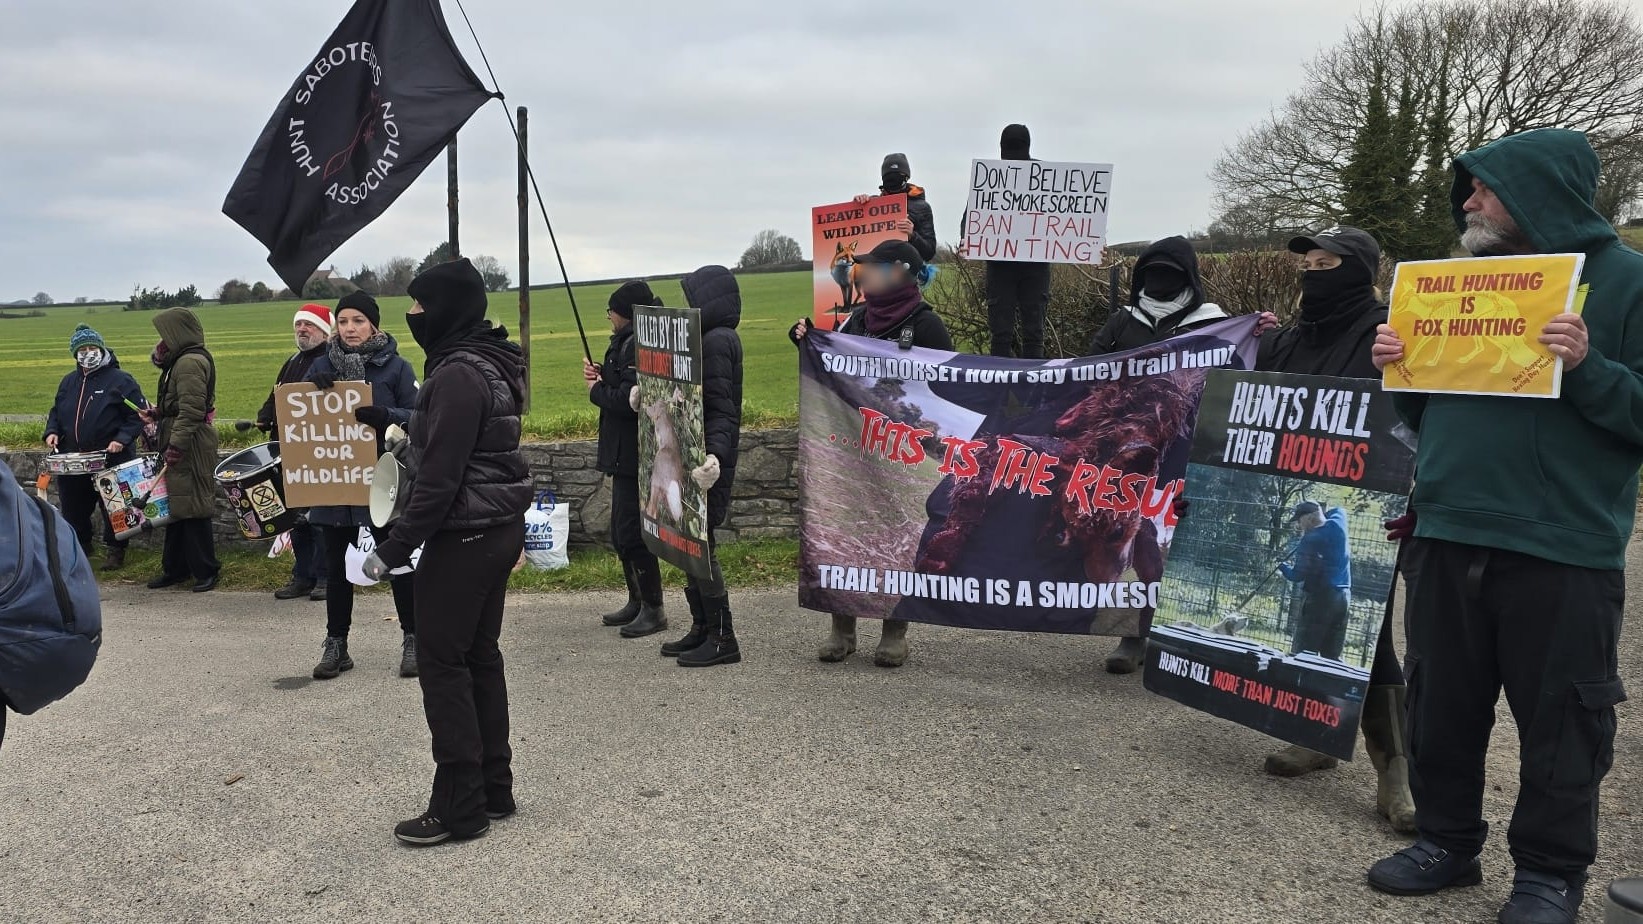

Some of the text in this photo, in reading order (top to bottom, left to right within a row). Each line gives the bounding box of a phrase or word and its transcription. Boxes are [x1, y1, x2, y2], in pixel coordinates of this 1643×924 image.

[289, 117, 321, 177] HUNT
[324, 101, 401, 205] ASSOCIATION
[1028, 162, 1110, 194] BELIEVE
[817, 203, 901, 225] LEAVE OUR
[973, 188, 1108, 214] THE SMOKESCREEN
[823, 220, 896, 240] WILDLIFE
[968, 210, 1012, 235] BAN
[1416, 272, 1544, 293] TRAIL HUNTING
[1460, 297, 1475, 314] IS
[637, 314, 690, 352] KILLED BY THE
[1413, 318, 1527, 337] FOX HUNTING
[673, 353, 692, 381] HUNT
[821, 344, 1237, 385] SOUTH DORSET HUNT say they trail hunt
[1512, 355, 1544, 384] Don't Support
[1528, 370, 1540, 380] Day
[286, 389, 361, 418] STOP
[1228, 382, 1371, 438] HUNTS KILL
[314, 444, 354, 460] OUR
[1223, 428, 1369, 481] THEIR HOUNDS
[937, 436, 988, 485] IS
[988, 438, 1060, 499] THE
[818, 564, 879, 593] TRAIL
[884, 569, 980, 604] HUNTING
[986, 578, 1011, 606] IS
[1015, 580, 1034, 607] A
[1158, 651, 1342, 728] HUNTS KILL MORE THAN JUST FOXES
